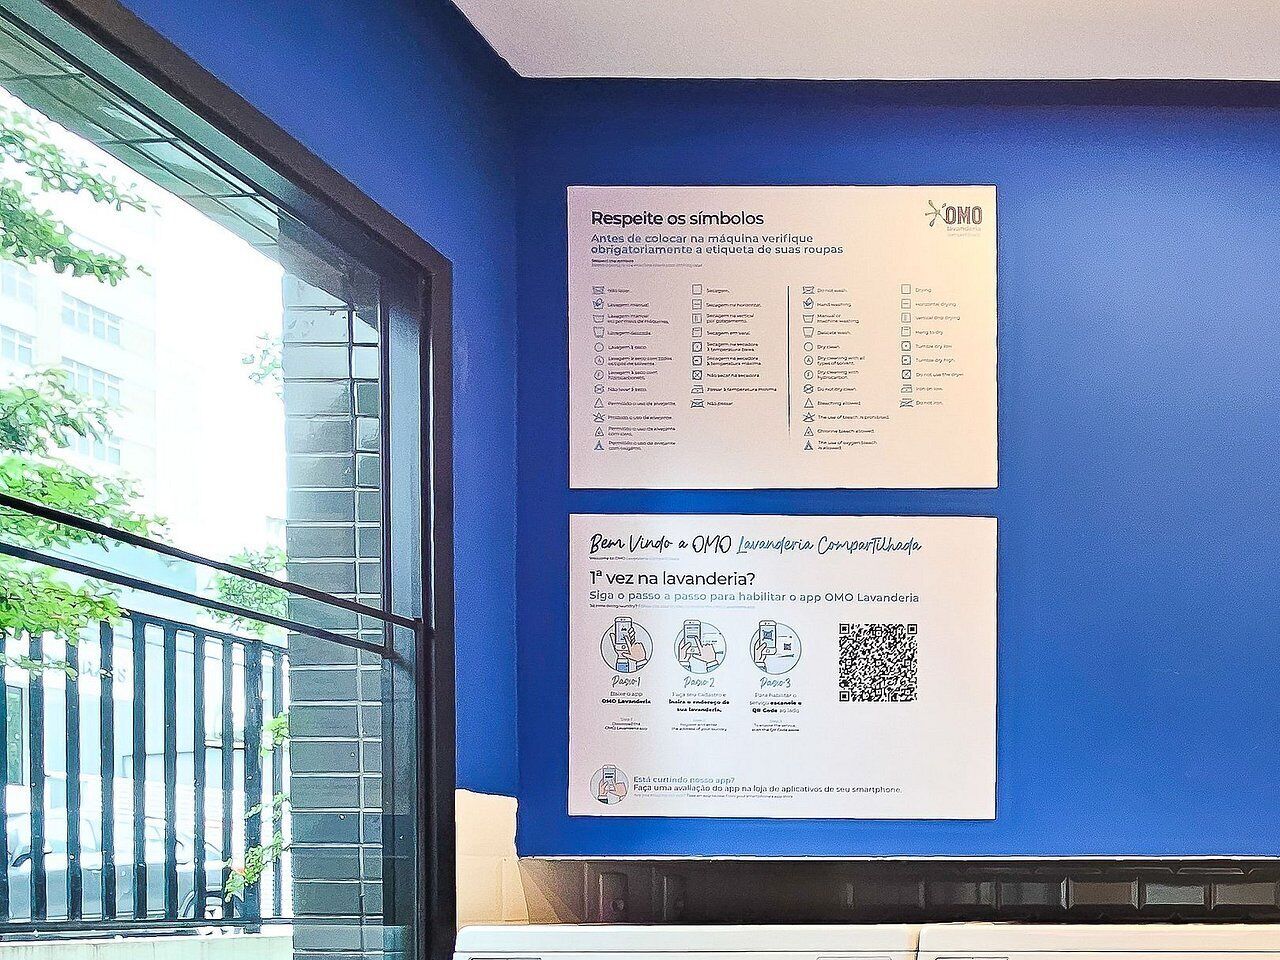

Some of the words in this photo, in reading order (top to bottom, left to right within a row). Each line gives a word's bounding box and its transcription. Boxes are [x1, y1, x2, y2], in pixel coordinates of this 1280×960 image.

[592, 211, 663, 228] Respeite
[667, 215, 686, 225] os
[689, 211, 764, 225] símbolos
[946, 204, 982, 225] OMO
[591, 234, 624, 243] Antes
[627, 233, 641, 243] de
[645, 234, 687, 243] colocar
[708, 234, 758, 244] máquina
[762, 233, 813, 244] verifique
[591, 244, 693, 256] obrigatoriamente
[706, 244, 754, 256] etiqueta
[757, 245, 772, 254] de
[804, 246, 843, 256] roupas
[590, 533, 625, 554] Bem
[629, 535, 673, 553] Vindo
[678, 540, 688, 548] a
[692, 535, 732, 554] OMO
[736, 536, 814, 554] Lavanderia
[818, 536, 922, 555] Compartilhada
[606, 574, 634, 584] vez
[638, 574, 658, 585] na
[663, 571, 755, 586] lavanderia?
[589, 590, 614, 601] Siga
[628, 592, 661, 602] passo
[674, 593, 707, 602] passo
[710, 594, 735, 602] para
[739, 591, 786, 601] habilitar
[800, 594, 821, 603] app
[825, 593, 854, 602] OMO
[857, 593, 919, 602] Lavanderia
